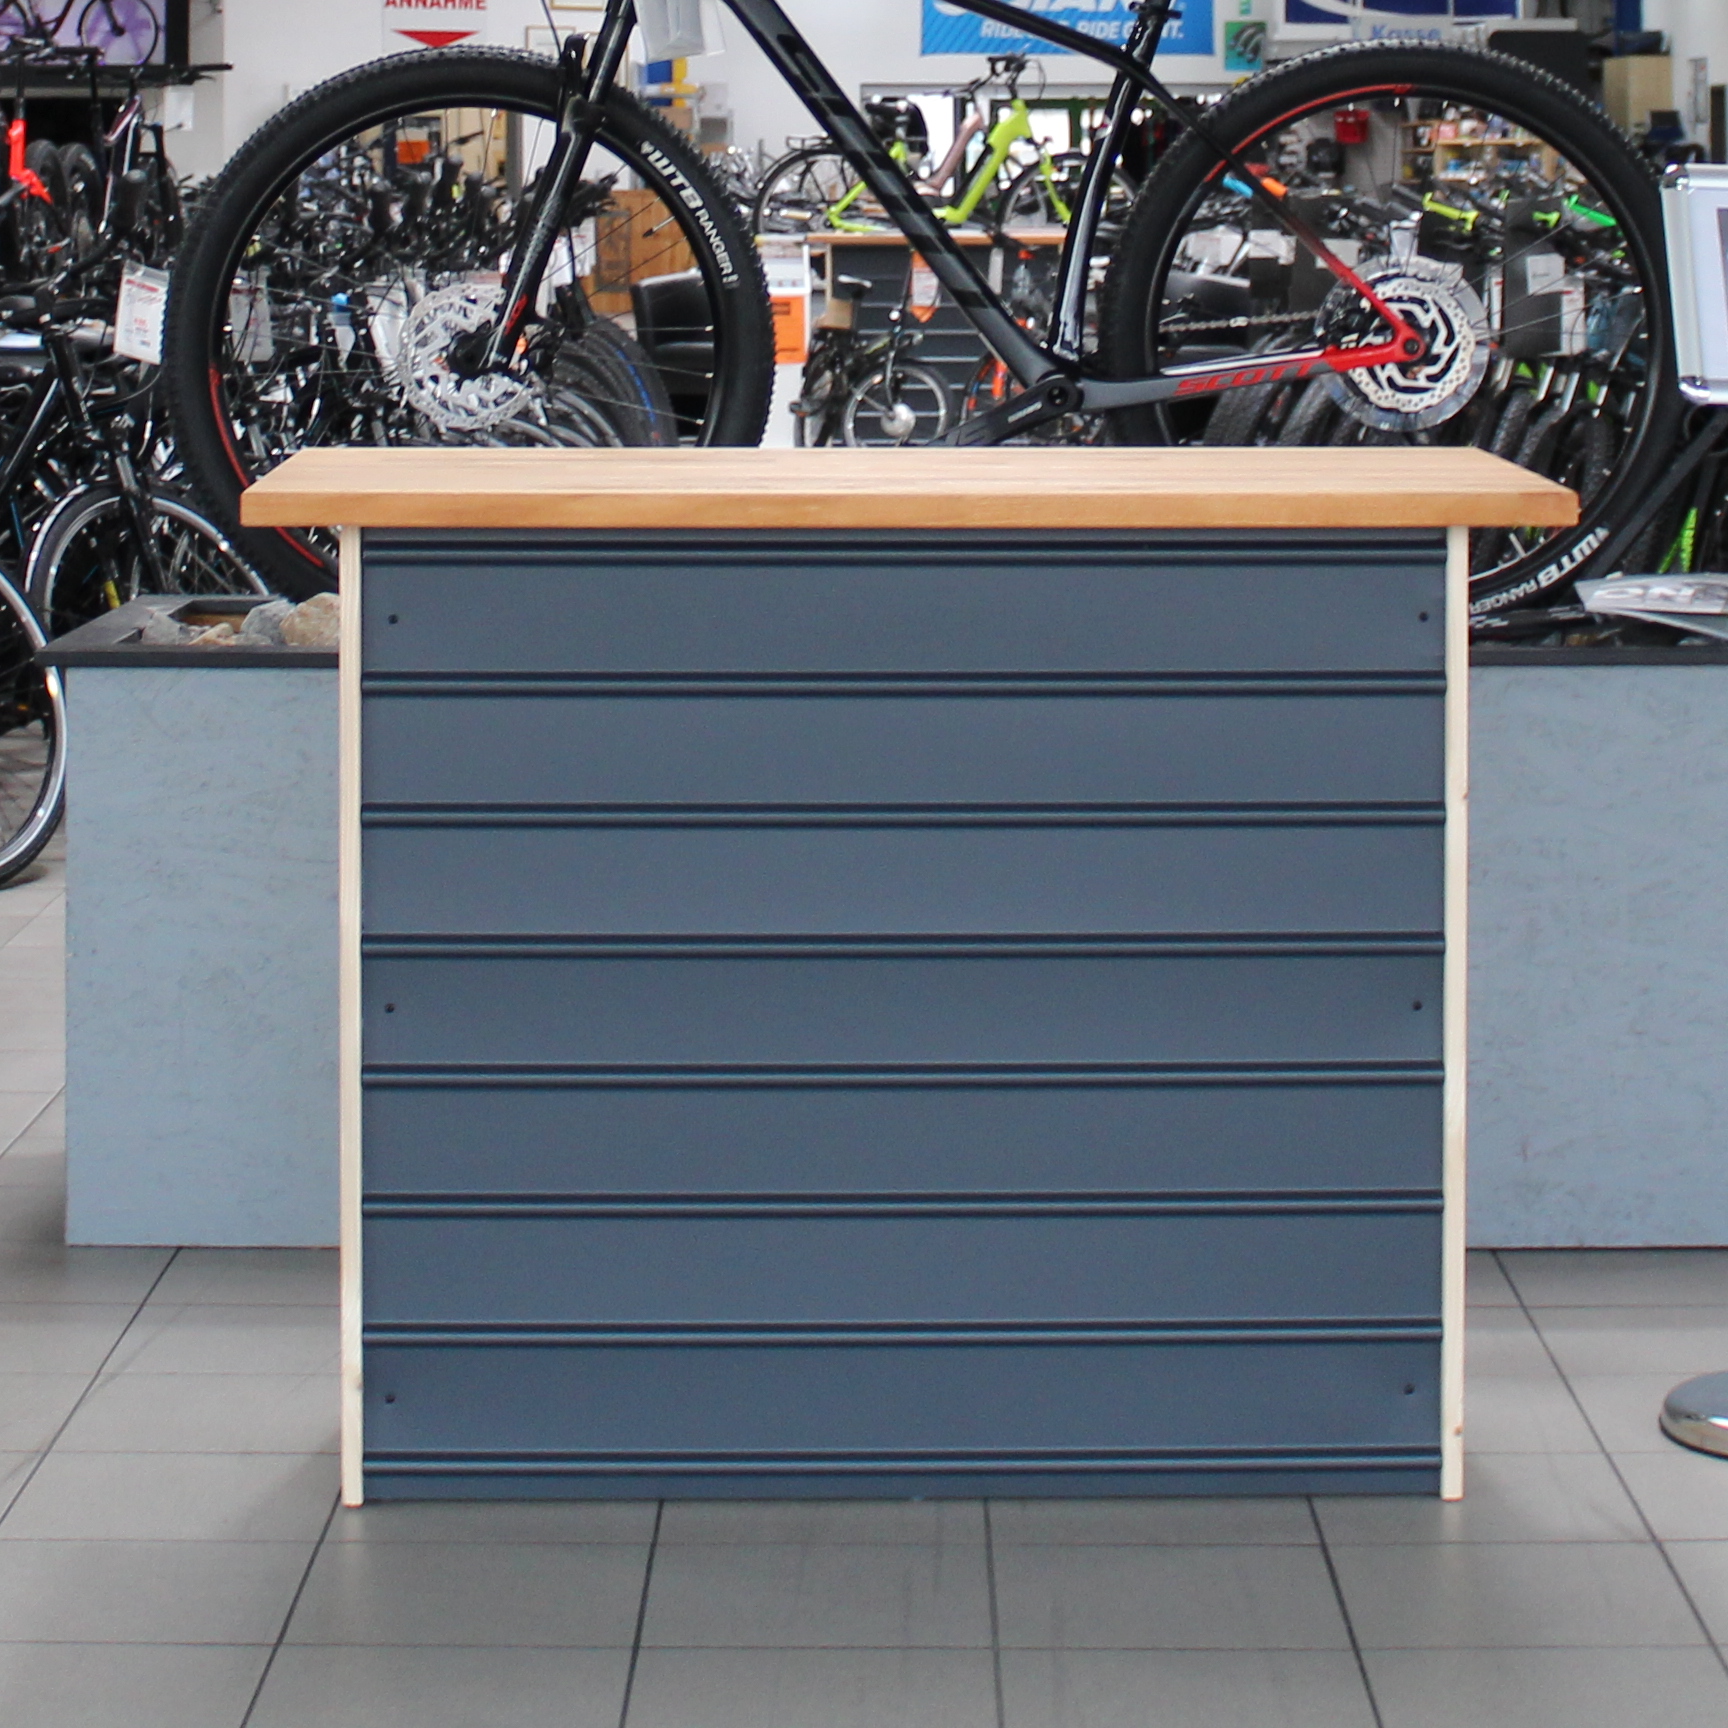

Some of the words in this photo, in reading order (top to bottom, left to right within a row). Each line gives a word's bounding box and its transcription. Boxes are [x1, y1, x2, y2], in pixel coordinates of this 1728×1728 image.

[647, 149, 704, 209] WTB
[695, 207, 734, 276] RANGER
[1173, 360, 1321, 396] SCOTT
[1538, 533, 1603, 588] WTB
